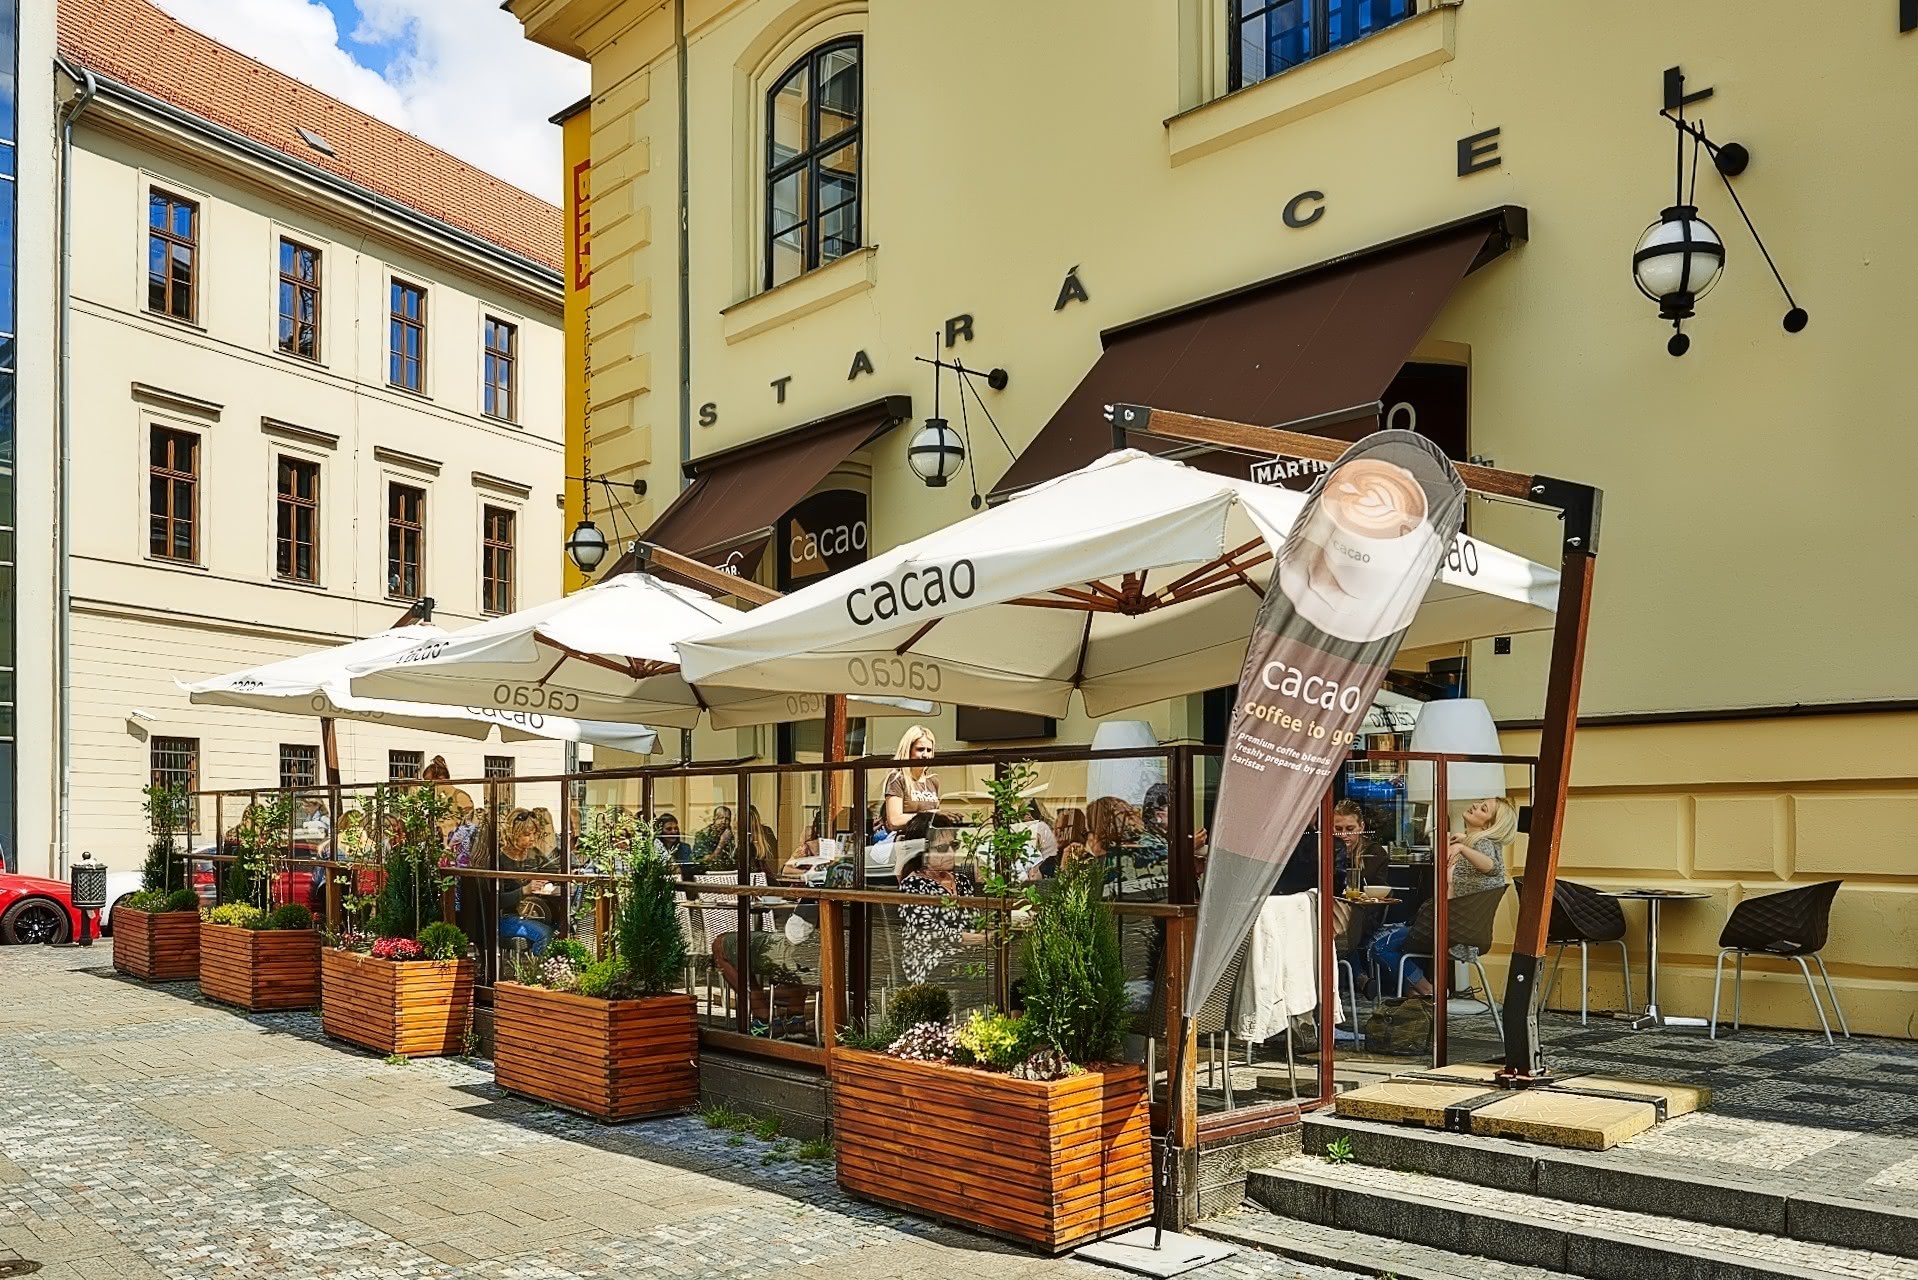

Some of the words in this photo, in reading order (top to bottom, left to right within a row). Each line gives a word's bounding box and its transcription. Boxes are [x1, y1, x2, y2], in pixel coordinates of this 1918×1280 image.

[1257, 460, 1330, 484] MARTIN
[789, 520, 867, 563] cacao
[1333, 540, 1371, 563] cacao
[846, 558, 976, 626] cacao
[1261, 660, 1361, 715] cacao
[1243, 701, 1303, 733] coffee
[1307, 720, 1326, 740] to
[1331, 729, 1355, 747] go
[1231, 753, 1266, 772] baristas
[1235, 742, 1265, 761] freshly
[1264, 754, 1302, 772] prepared
[1302, 765, 1316, 776] by
[1315, 768, 1332, 777] our
[1237, 731, 1275, 750] premium
[1275, 744, 1301, 760] coffee
[1301, 751, 1332, 767] blends
